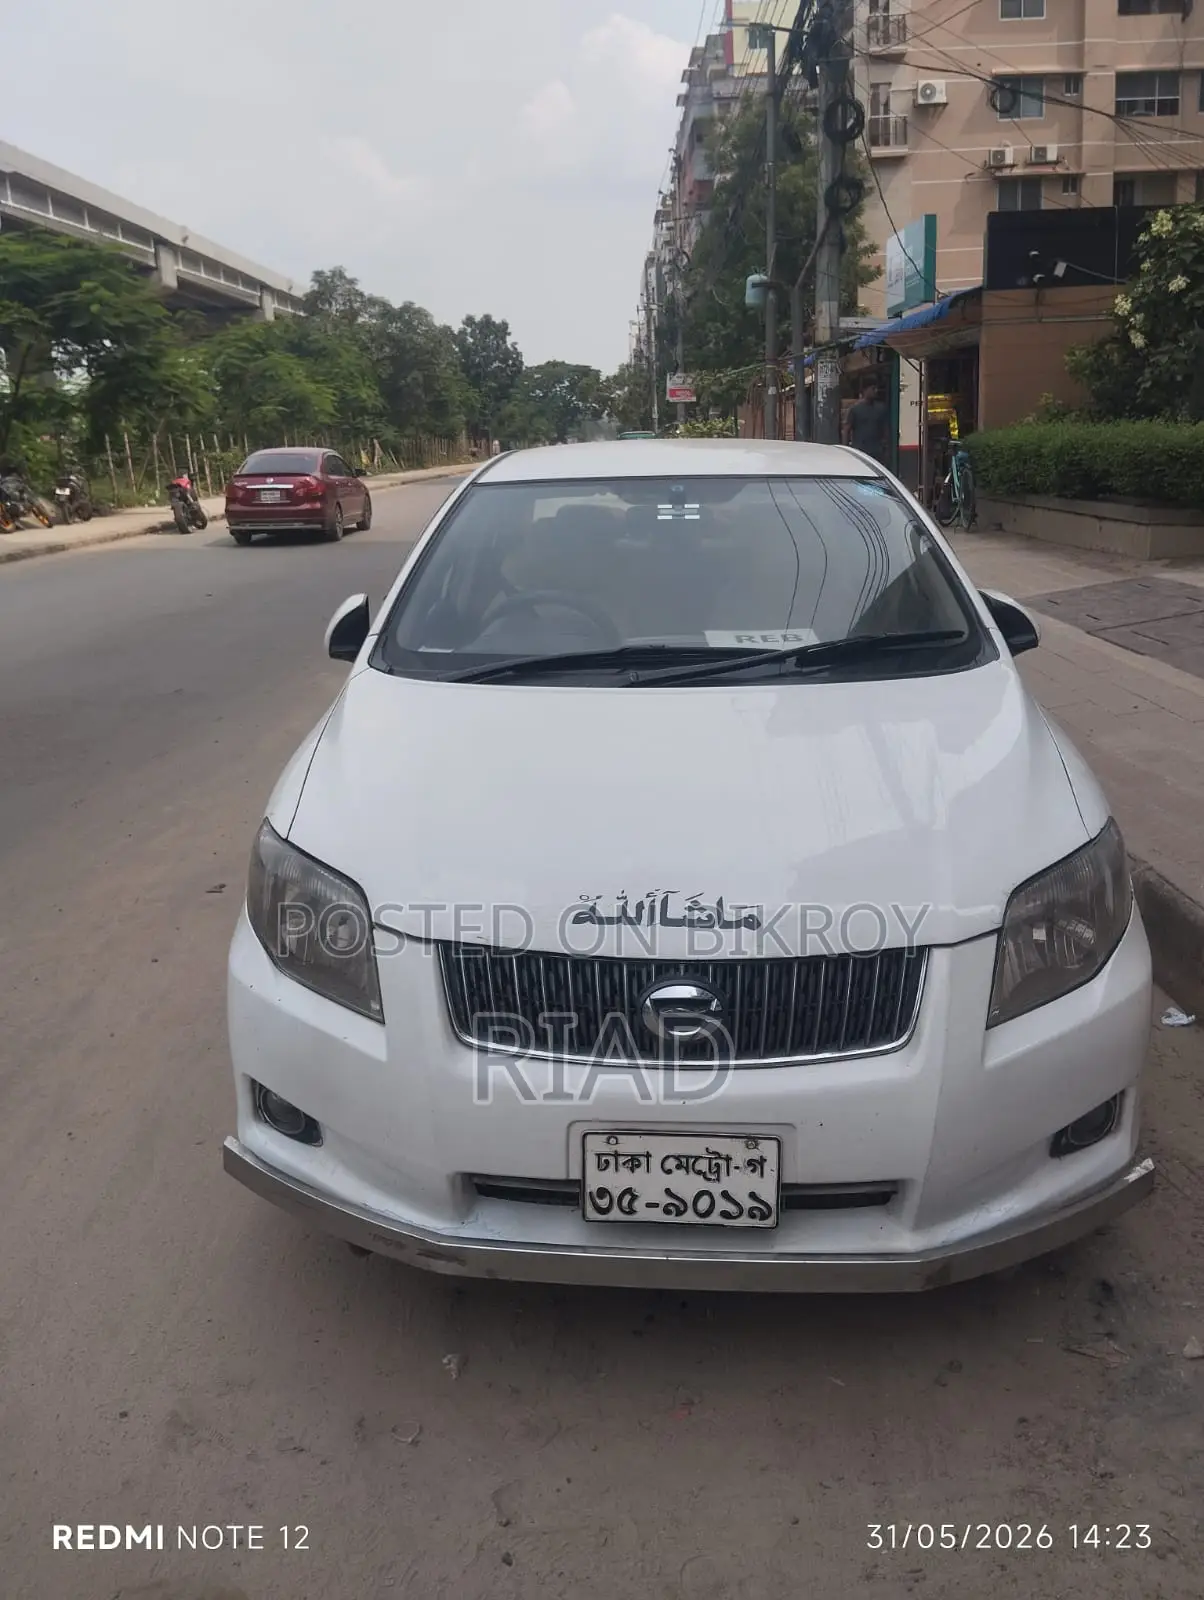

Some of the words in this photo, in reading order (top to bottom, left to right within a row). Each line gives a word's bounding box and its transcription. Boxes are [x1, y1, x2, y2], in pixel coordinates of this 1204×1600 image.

[734, 633, 803, 644] REB
[595, 1150, 652, 1174] ঢাকা
[588, 1185, 773, 1222] ৩৫-৯০১৯
